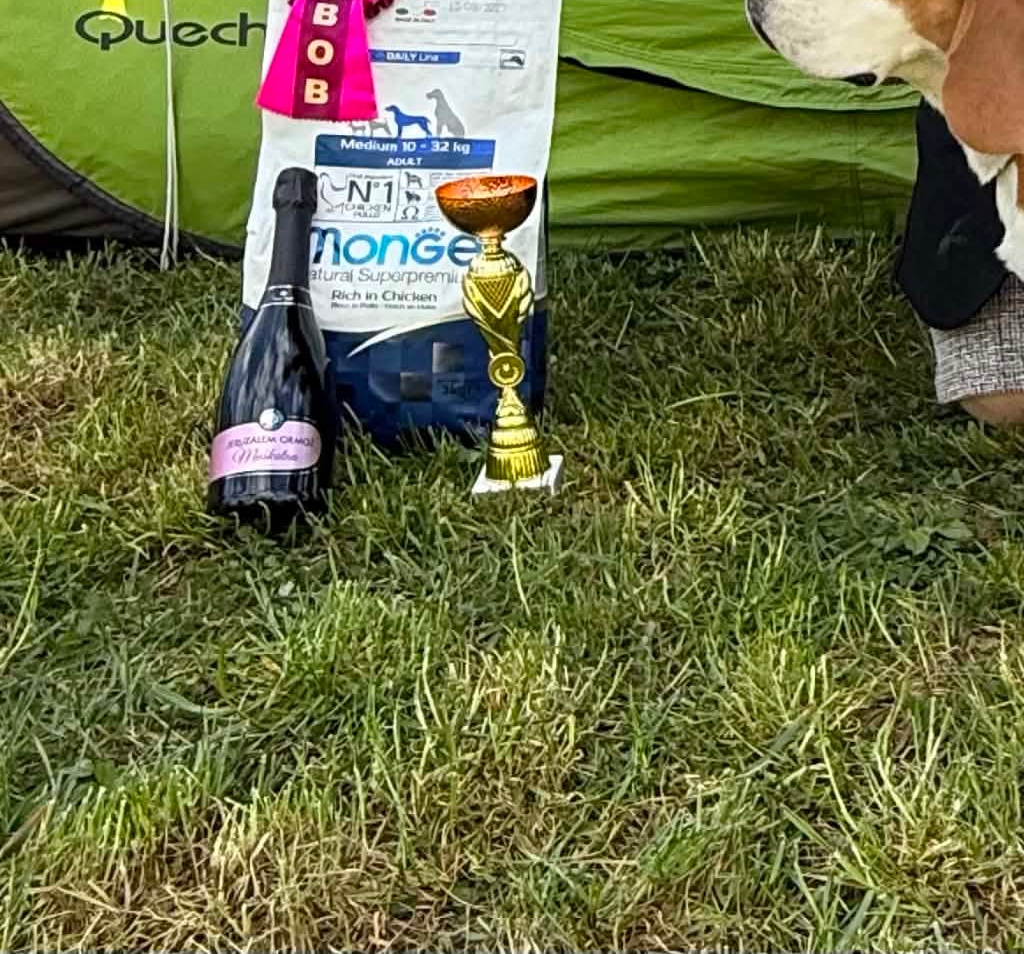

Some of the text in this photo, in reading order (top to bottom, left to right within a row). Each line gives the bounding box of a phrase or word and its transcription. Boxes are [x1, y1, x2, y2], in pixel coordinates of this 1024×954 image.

[303, 2, 340, 105] BOB
[386, 51, 416, 62] DAILY
[340, 139, 398, 152] Medium
[402, 140, 416, 152] 10
[432, 140, 450, 153] 32
[453, 140, 471, 154] kg
[386, 157, 423, 167] ADULT
[331, 289, 438, 303] Rich in Chicken
